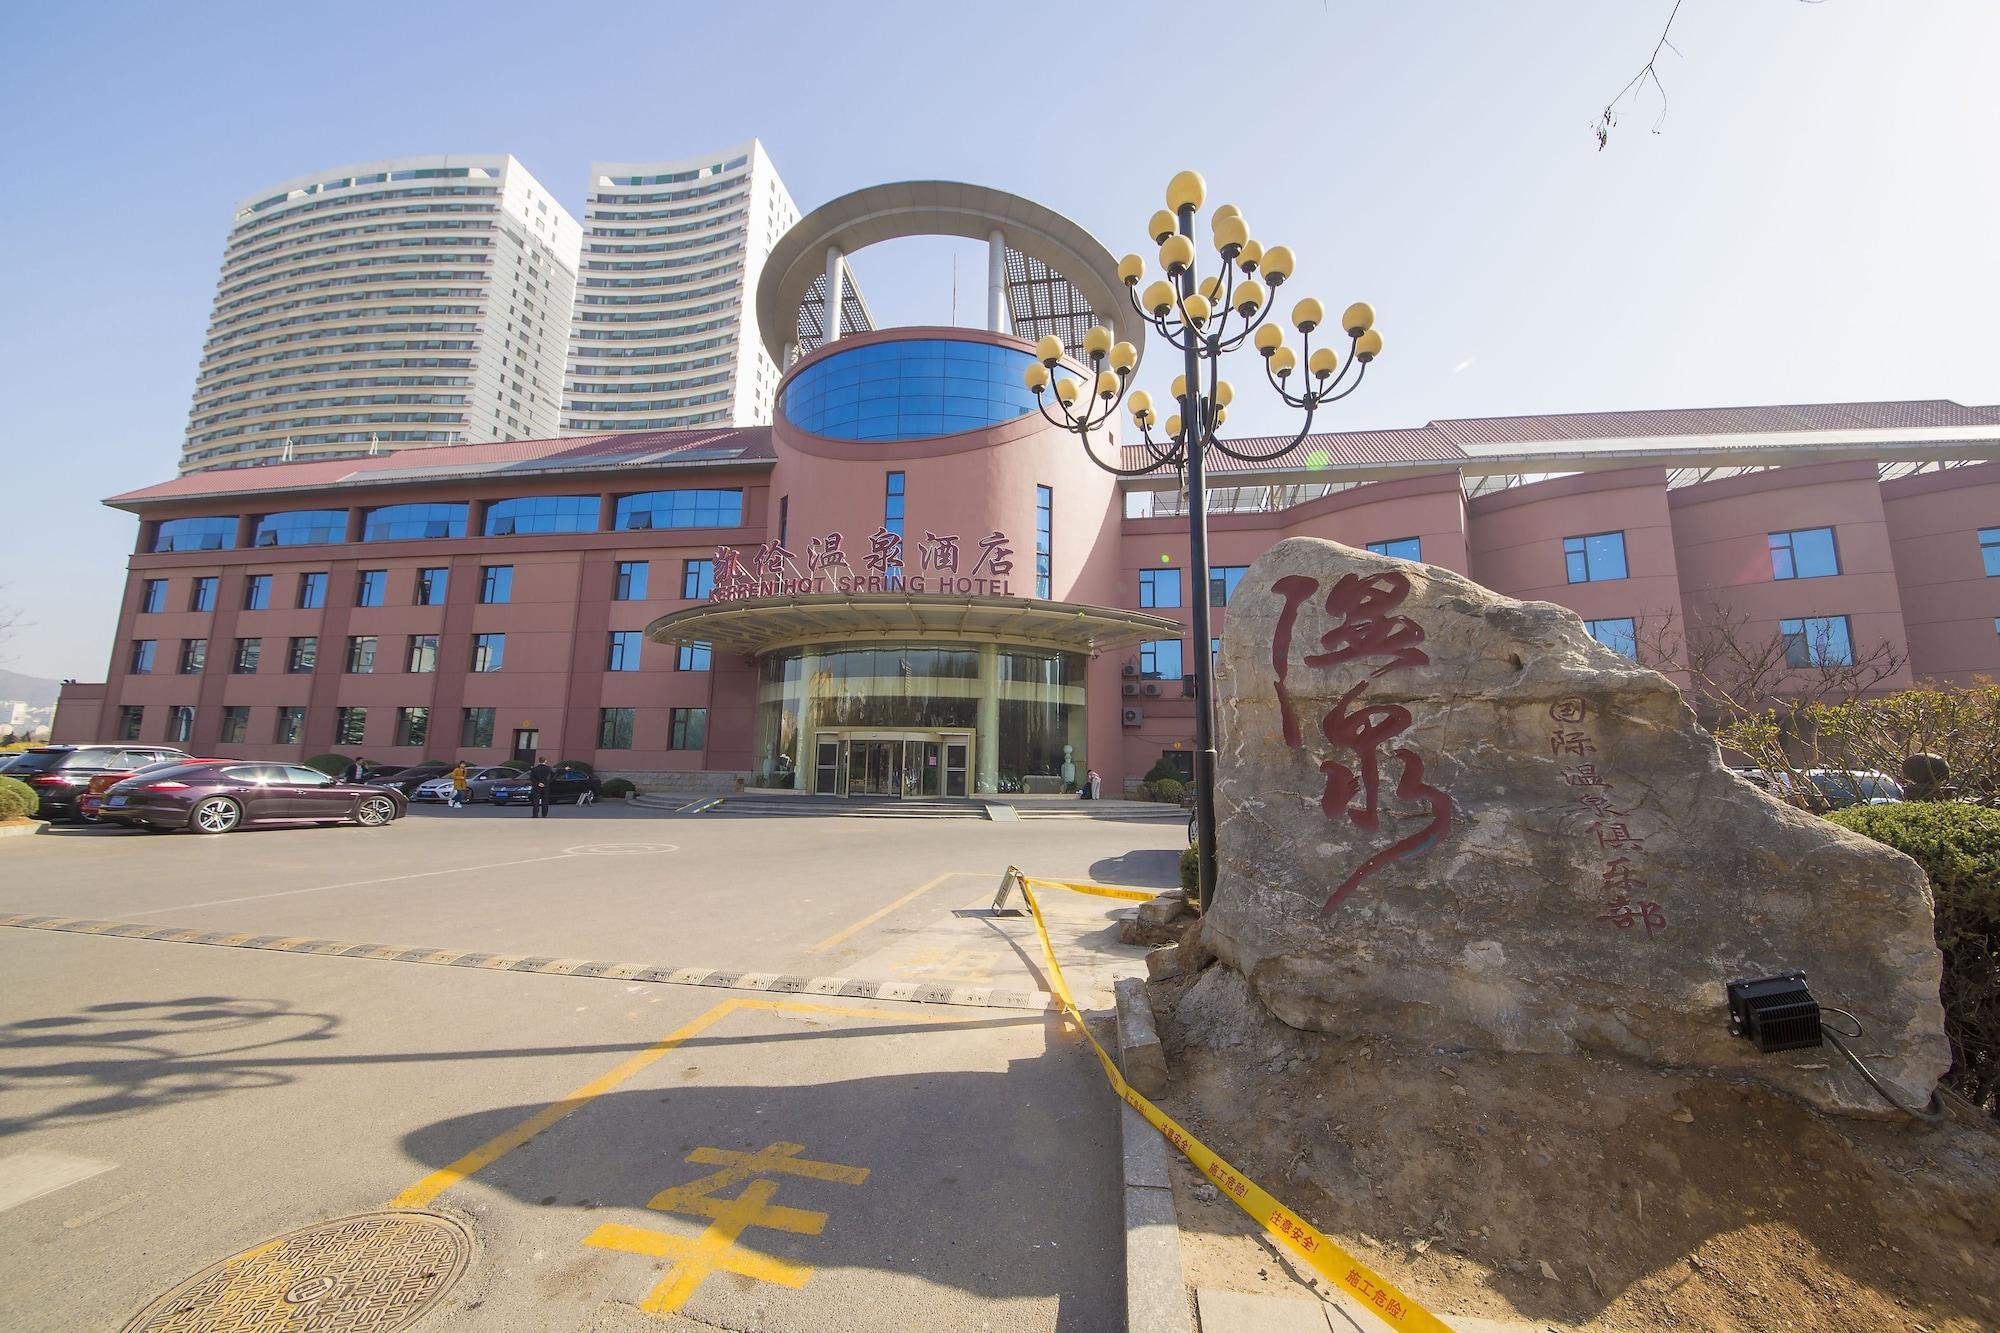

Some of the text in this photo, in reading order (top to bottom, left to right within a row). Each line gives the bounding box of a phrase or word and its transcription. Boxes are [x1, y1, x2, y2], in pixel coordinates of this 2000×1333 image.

[784, 577, 827, 595] HOT
[838, 575, 925, 594] SPRING
[939, 577, 1015, 596] HOTEL
[1549, 695, 1668, 940] 国际温泉俱乐部
[1207, 1161, 1250, 1200] 施工危险!
[1268, 1210, 1320, 1255] 注意安全!
[1344, 1268, 1408, 1322] 施工危险!
